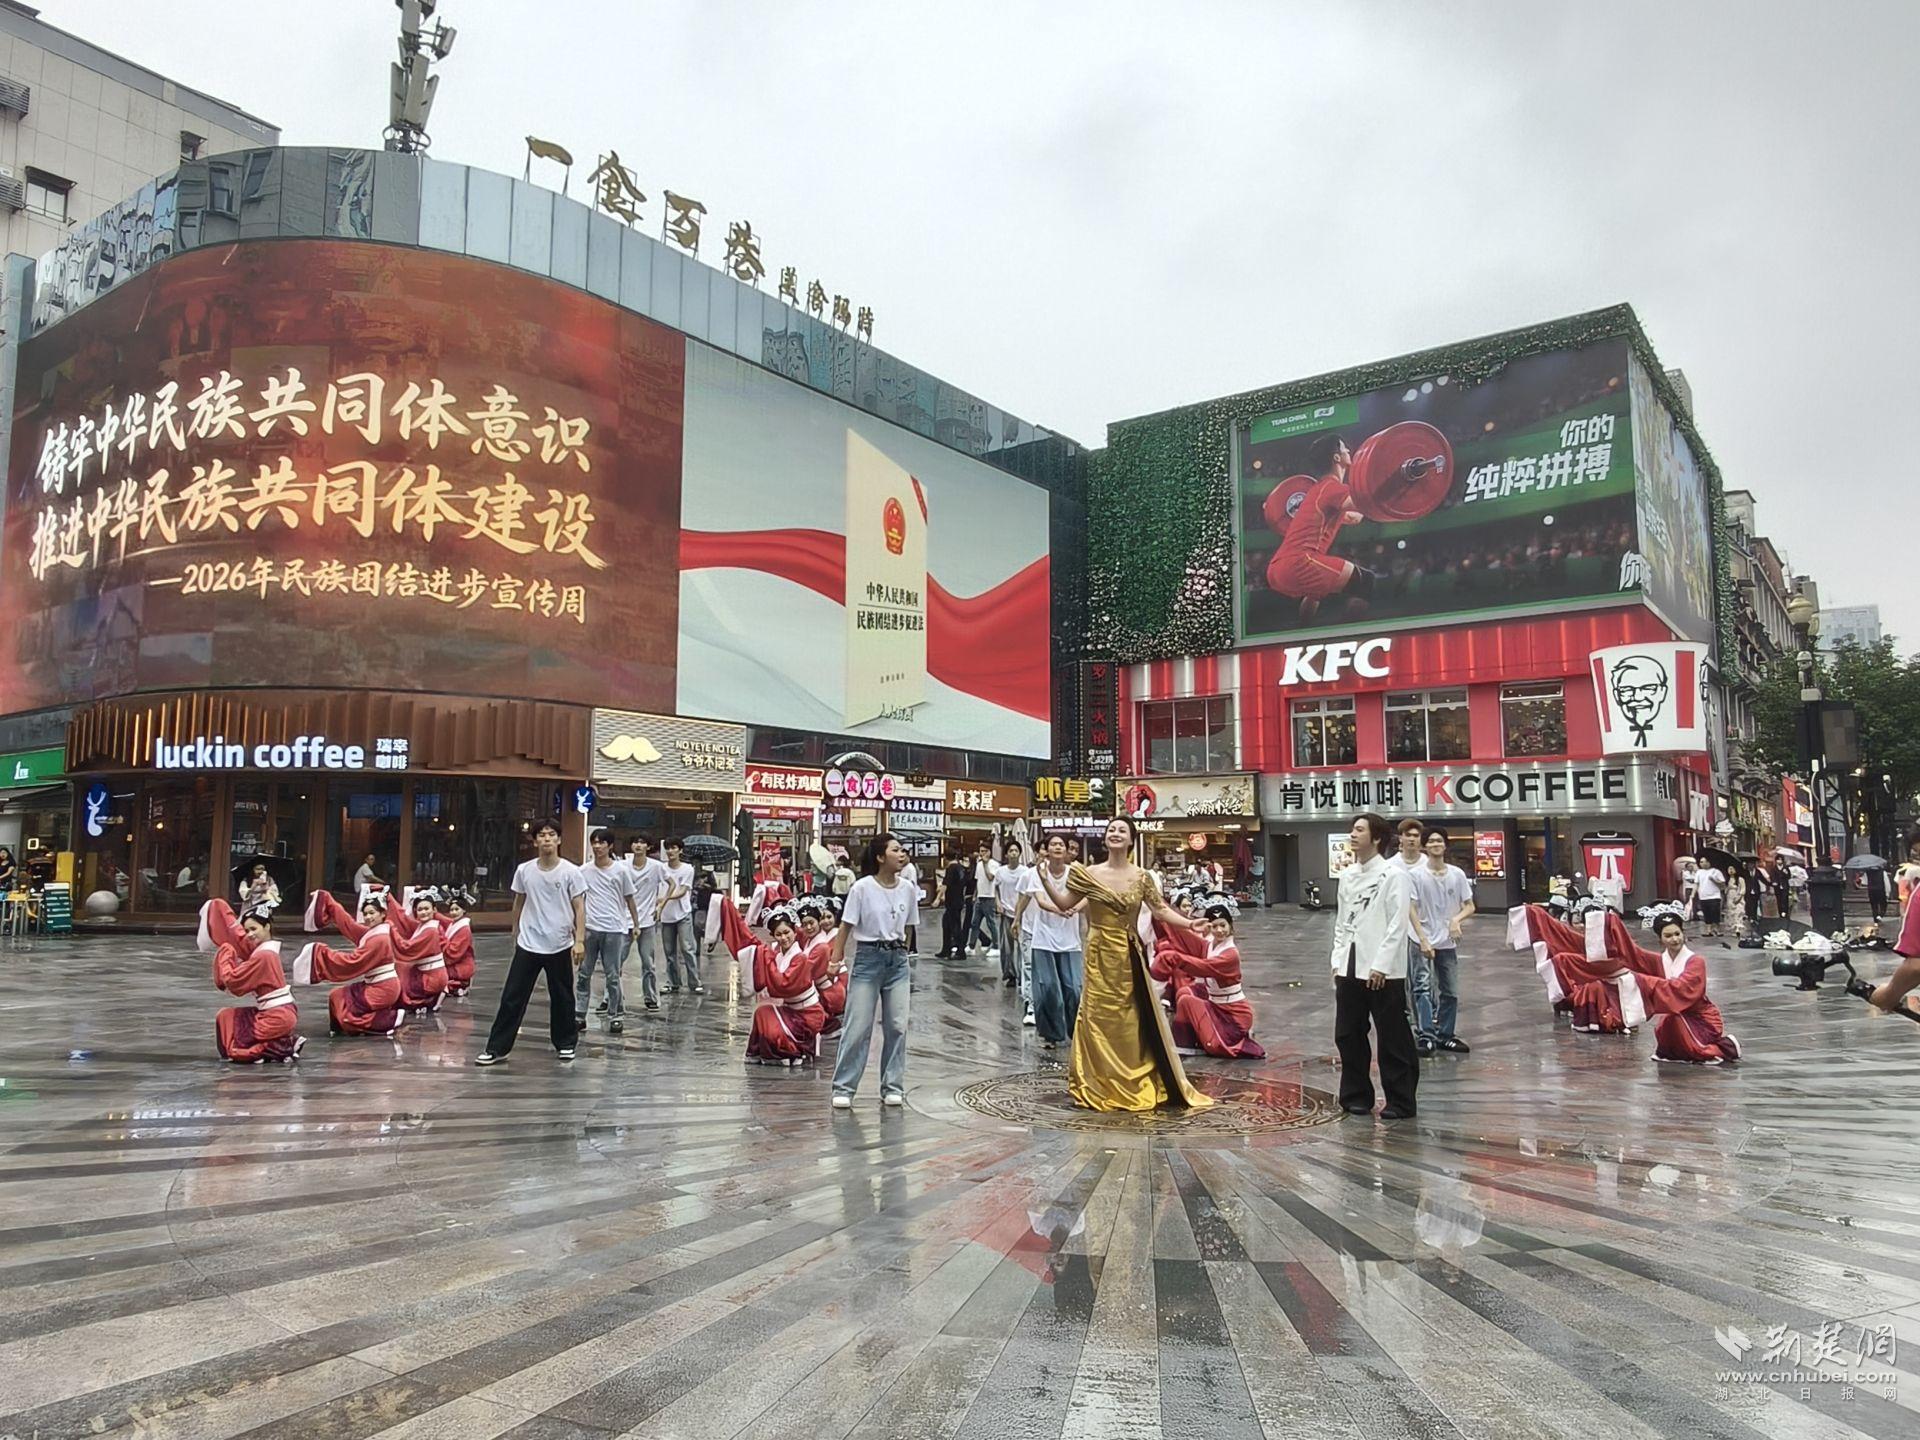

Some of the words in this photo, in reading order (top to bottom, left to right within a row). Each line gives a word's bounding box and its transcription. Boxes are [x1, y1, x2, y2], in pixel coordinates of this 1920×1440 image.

[35, 367, 592, 494] 铸牢中华民族共同体意识
[1560, 413, 1615, 449] 你的
[1464, 443, 1612, 504] 纯粹拼搏
[28, 459, 608, 581] 推进中华民族共同体建设
[866, 581, 919, 606] 中华人民共和国
[857, 609, 924, 632] 民族团结进步促进法
[1279, 638, 1392, 686] KFC
[155, 735, 245, 769] luckin
[254, 736, 364, 769] coffee
[376, 737, 409, 753] 瑞幸
[675, 739, 690, 750] NO
[689, 741, 711, 753] YEYE
[712, 744, 725, 754] NO
[726, 745, 742, 756] TEA
[375, 754, 409, 770] 咖啡
[827, 775, 894, 796] 一食万巷
[952, 788, 994, 811] 真茶屋
[1279, 776, 1403, 811] 肯悦咖啡
[1426, 768, 1628, 804] KCOFFEE
[1186, 799, 1243, 816] 茶颜悦色
